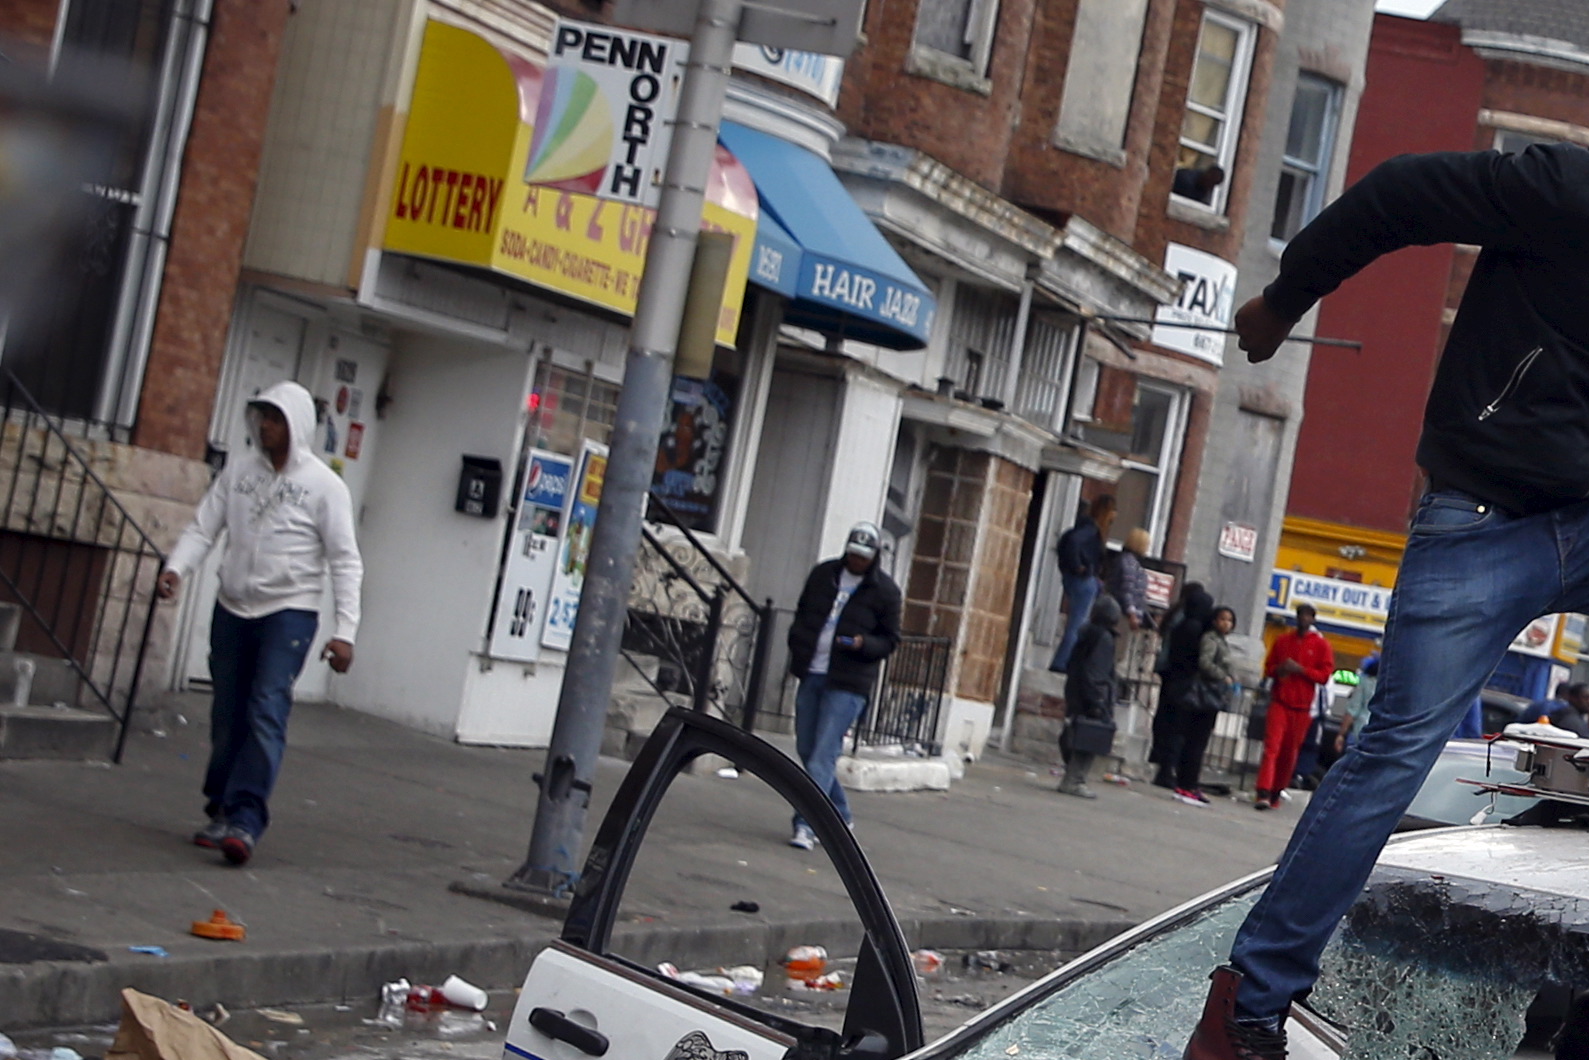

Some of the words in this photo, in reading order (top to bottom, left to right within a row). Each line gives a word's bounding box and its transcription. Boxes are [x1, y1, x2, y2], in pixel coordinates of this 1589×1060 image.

[554, 26, 667, 74] PENN
[395, 162, 504, 235] LOTTERY
[811, 262, 877, 310] HAIR
[878, 285, 921, 328] JAZZ
[1177, 269, 1227, 318] TAX
[1294, 579, 1339, 603] CARRY
[1342, 586, 1369, 608] OUT
[1371, 593, 1381, 608] &
